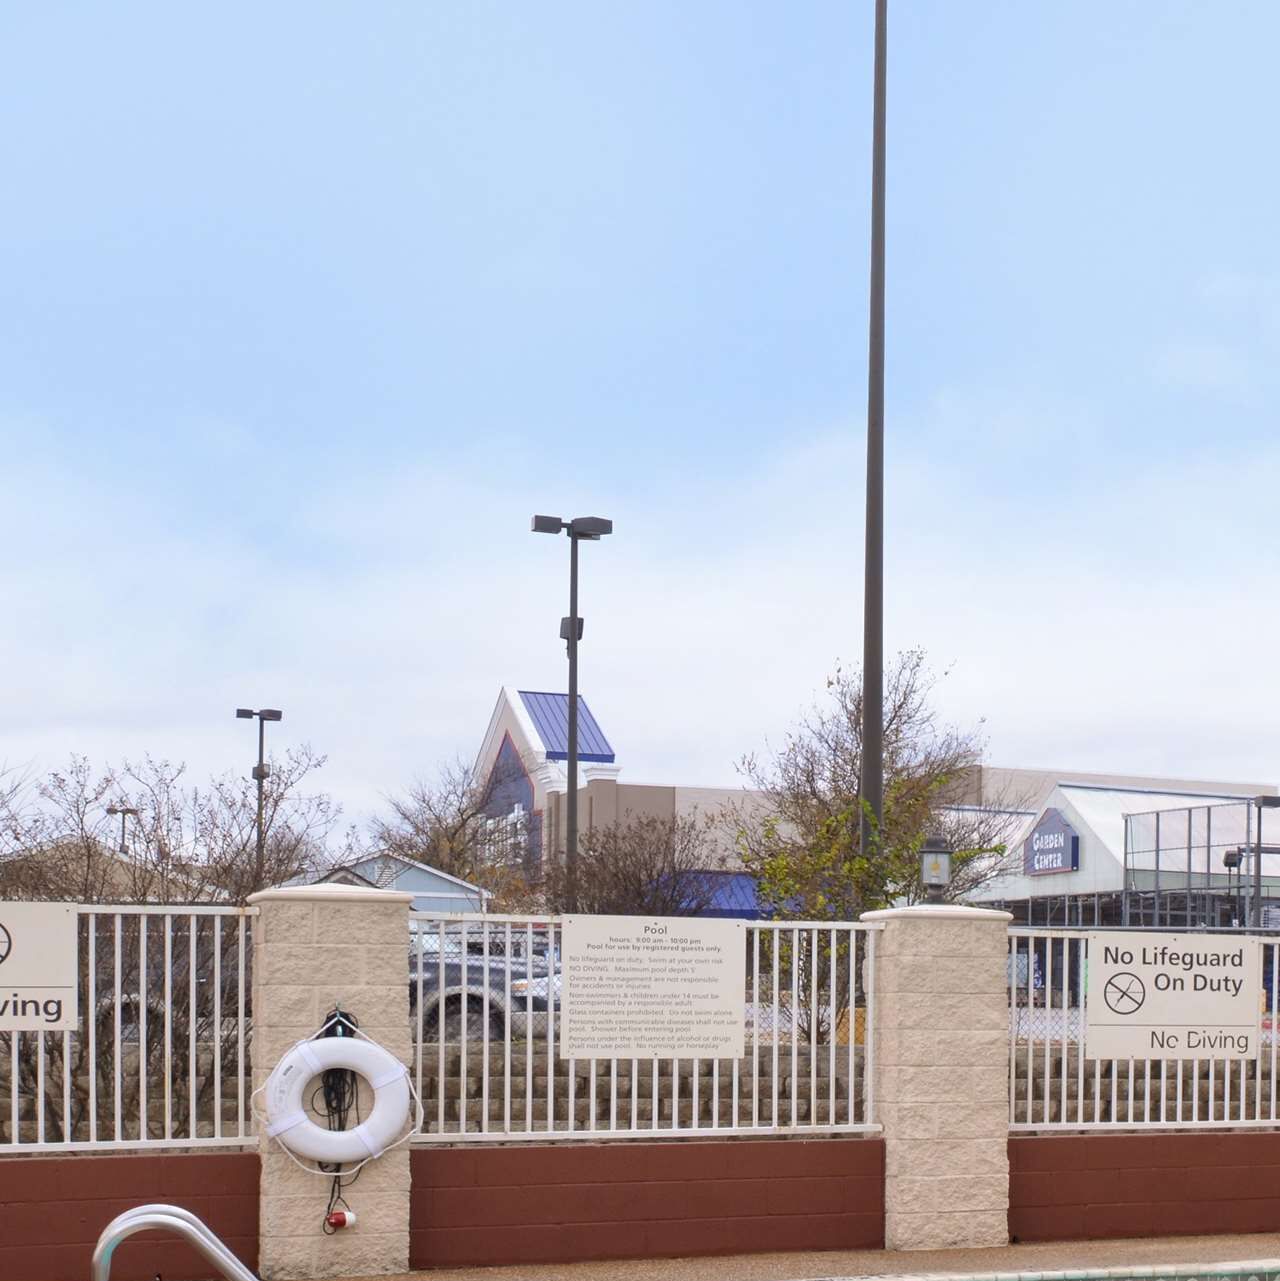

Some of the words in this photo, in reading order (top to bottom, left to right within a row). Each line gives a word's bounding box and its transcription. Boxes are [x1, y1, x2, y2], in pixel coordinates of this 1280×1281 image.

[644, 926, 668, 935] Pool
[1104, 946, 1133, 965] No
[1142, 946, 1243, 971] Lifeguard
[1154, 973, 1184, 992] On
[1193, 974, 1243, 997] Duty
[1151, 1031, 1179, 1049] No
[1187, 1030, 1248, 1054] Diving
